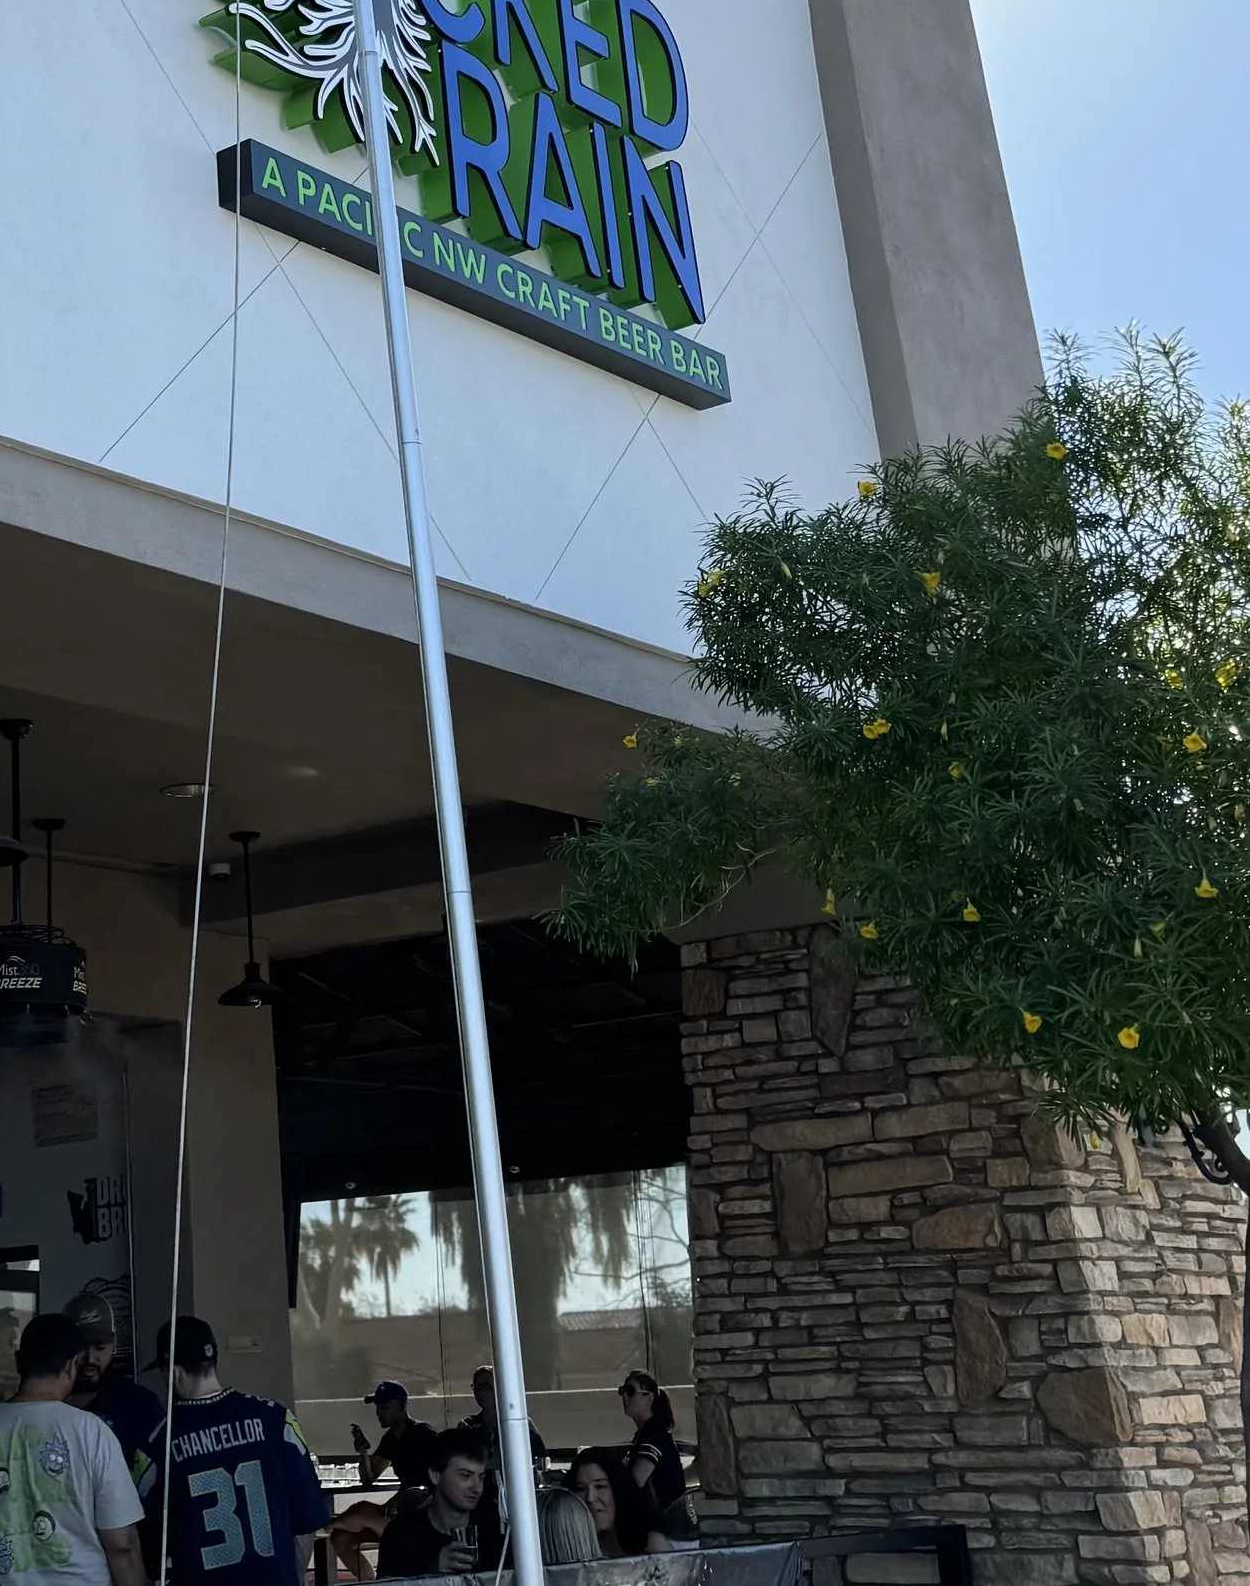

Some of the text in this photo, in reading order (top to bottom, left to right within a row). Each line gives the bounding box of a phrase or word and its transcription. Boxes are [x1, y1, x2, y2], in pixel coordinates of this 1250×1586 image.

[437, 41, 706, 324] RAIN
[261, 156, 725, 392] A PACIC NW CRAFT BEER BAR
[171, 1418, 265, 1463] CHANCELLOR
[188, 1459, 274, 1571] 31
